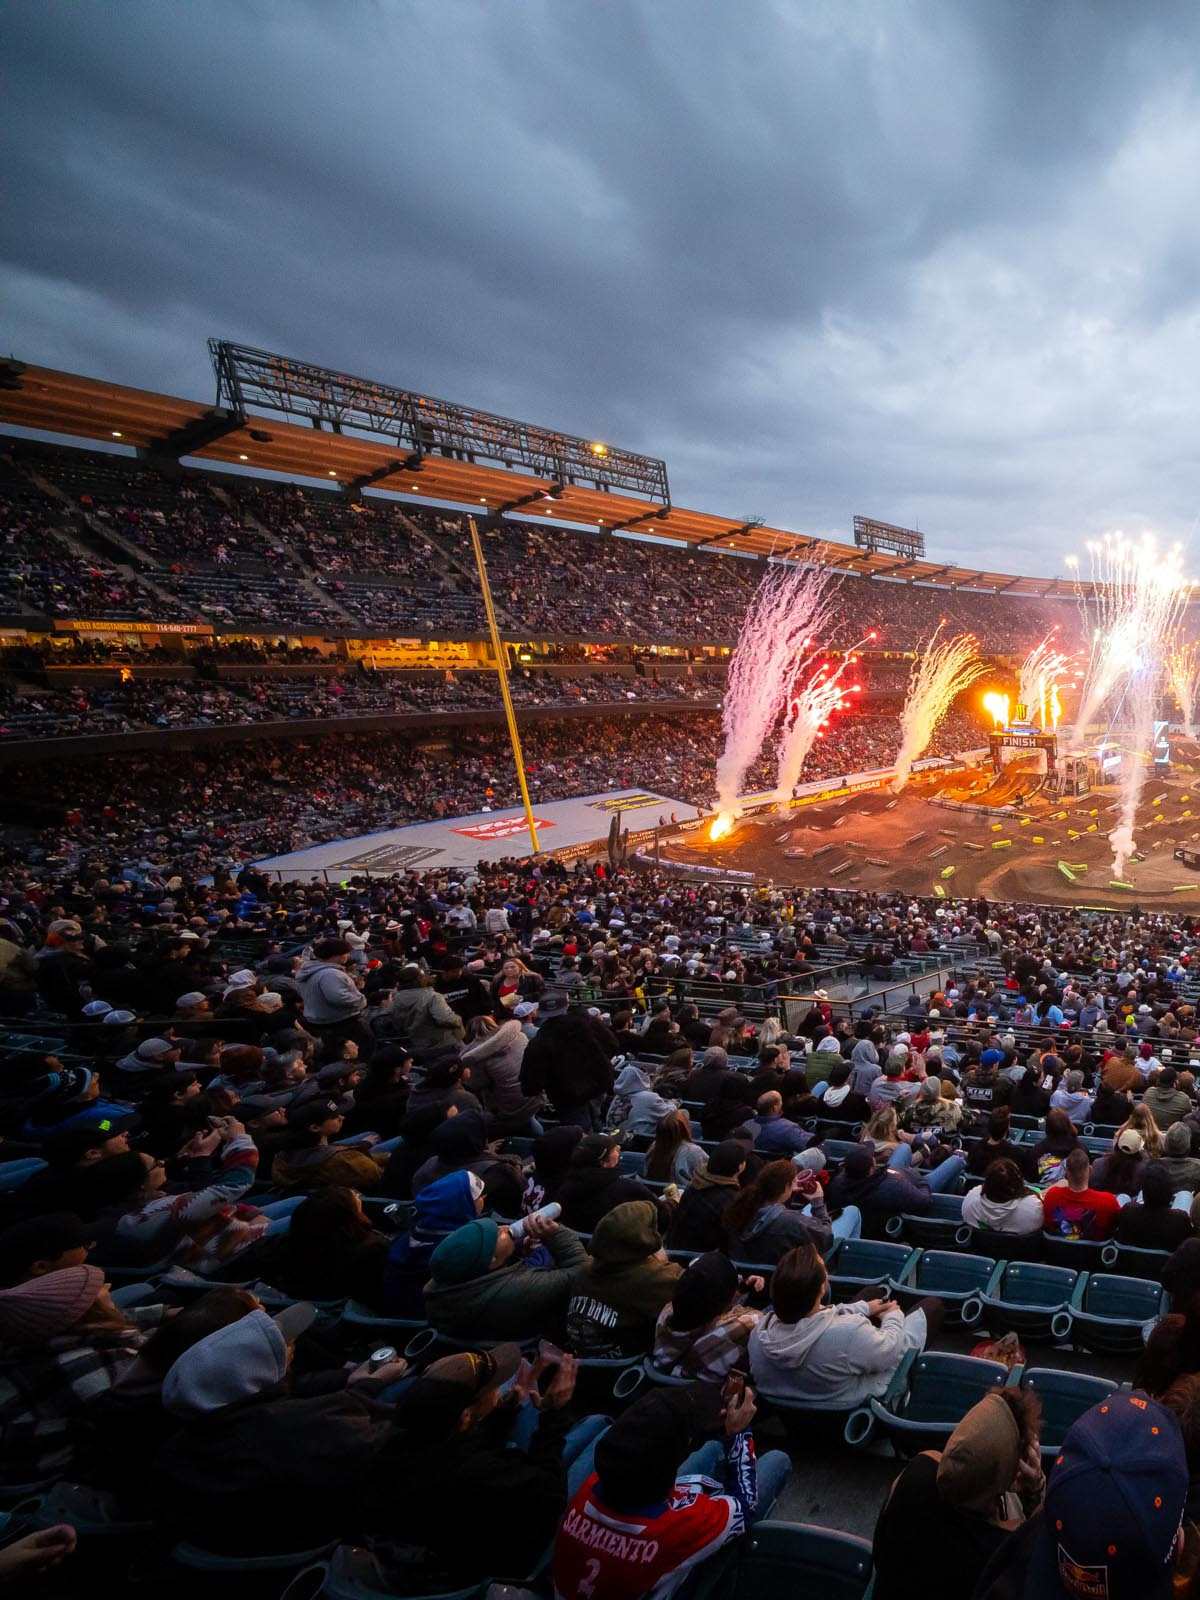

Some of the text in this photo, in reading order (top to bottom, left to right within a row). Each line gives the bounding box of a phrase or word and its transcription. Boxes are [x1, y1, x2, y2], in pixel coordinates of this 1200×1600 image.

[1003, 737, 1036, 747] FINISH
[850, 780, 881, 793] GASGAS
[563, 1507, 660, 1566] SARMIENTO
